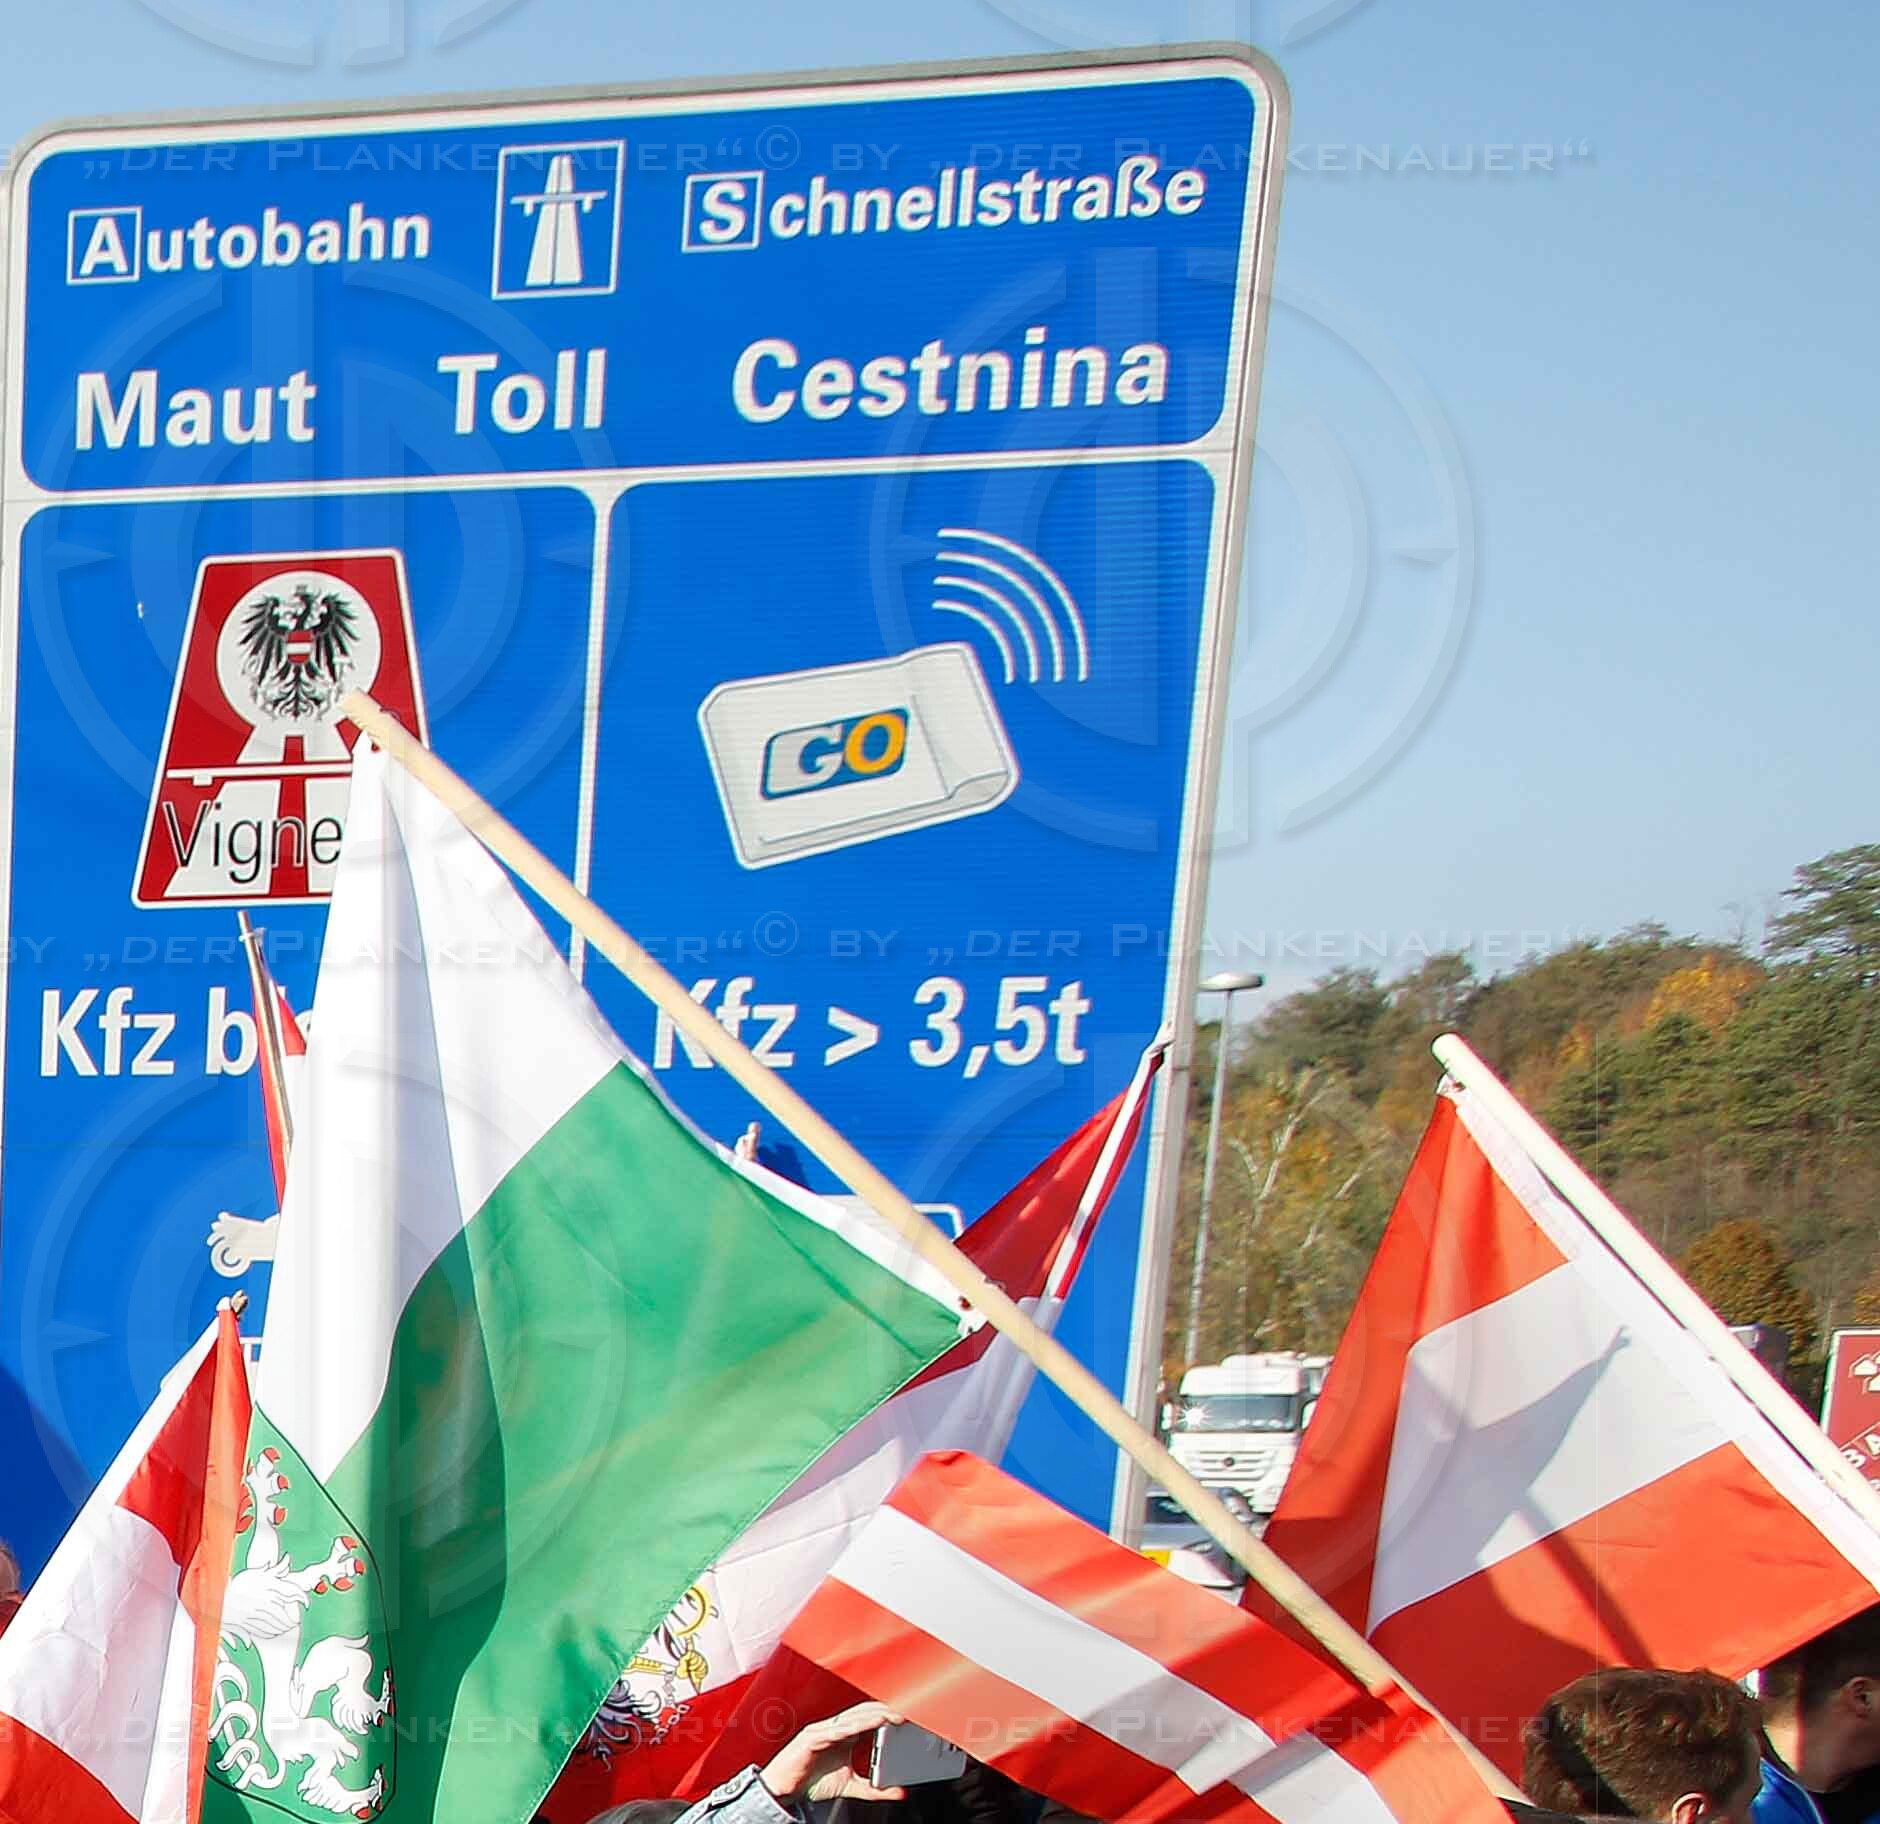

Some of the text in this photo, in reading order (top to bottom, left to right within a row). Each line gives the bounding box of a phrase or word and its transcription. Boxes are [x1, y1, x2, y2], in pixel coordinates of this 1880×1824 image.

[80, 203, 430, 276] Autobahn
[700, 154, 1205, 242] Schnellstraße
[76, 326, 1168, 449] Maut Toll Cestnina
[763, 709, 908, 798] GO
[162, 800, 342, 884] Vigne
[40, 986, 176, 1077] Kfz
[909, 975, 1093, 1079] 3,5t
